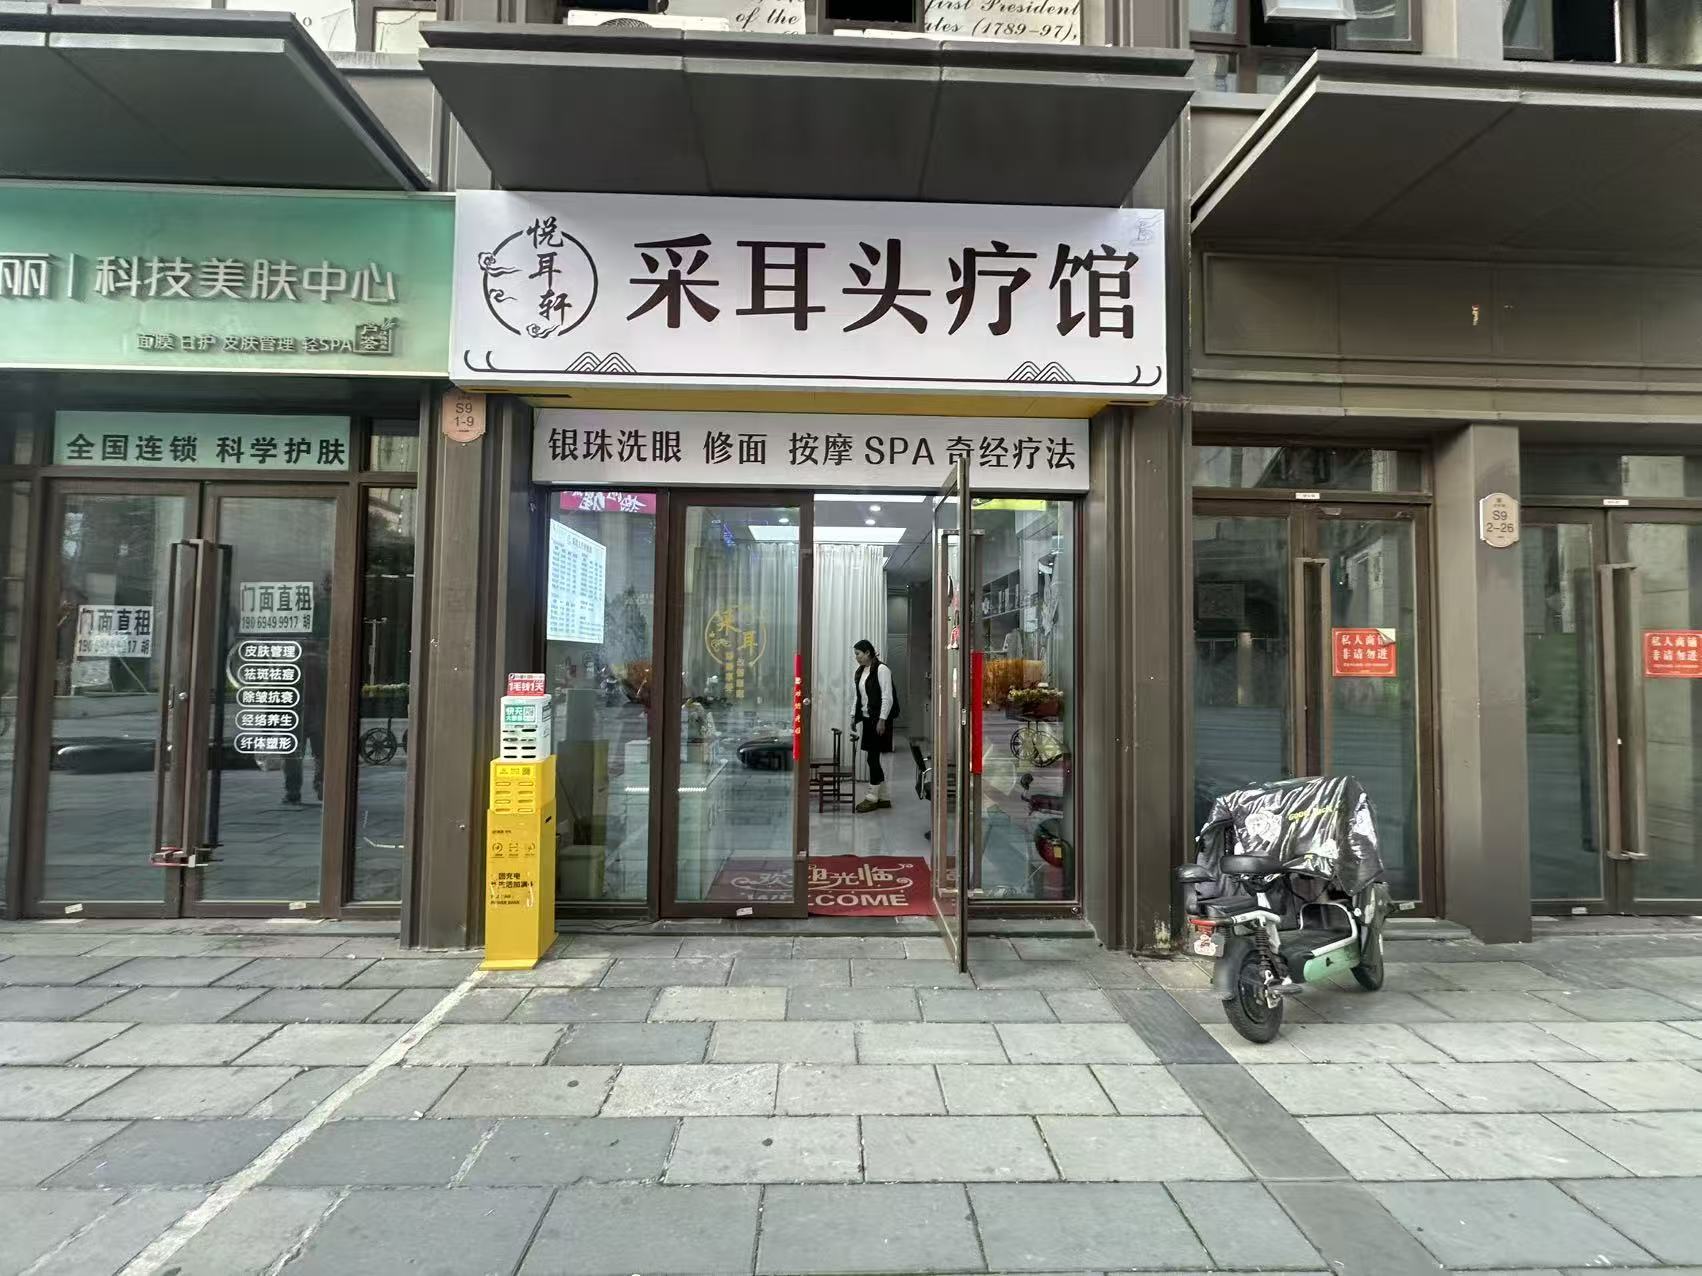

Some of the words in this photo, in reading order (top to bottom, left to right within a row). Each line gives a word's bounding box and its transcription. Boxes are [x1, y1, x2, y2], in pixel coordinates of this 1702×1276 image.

[736, 6, 760, 29] of
[767, 8, 800, 25] the
[95, 254, 397, 303] 科技美肤中心
[527, 216, 572, 325] 悦耳轩
[626, 233, 1140, 338] 采耳头疗馆
[224, 334, 296, 352] 皮肤管理
[302, 335, 353, 353] 轻SPA
[455, 402, 473, 414] S9
[454, 415, 474, 427] 1-9
[67, 433, 198, 462] 全国连锁
[216, 435, 346, 466] 科学护肤
[548, 428, 682, 463] 银珠洗眼
[703, 431, 768, 465] 修面
[789, 432, 853, 466] 按摩
[865, 436, 935, 465] SPA
[946, 435, 1076, 470] 奇经疗法
[1492, 510, 1508, 521] S9
[1486, 522, 1514, 533] 2-26
[241, 584, 312, 613] 门面直租
[80, 608, 150, 635] 门面直租
[244, 645, 296, 658] 皮肤管理
[244, 668, 295, 681] 祛斑祛痘
[242, 691, 293, 704] 除皱抗衰
[241, 714, 293, 727] 经络养生
[240, 737, 292, 750] 纤体塑形
